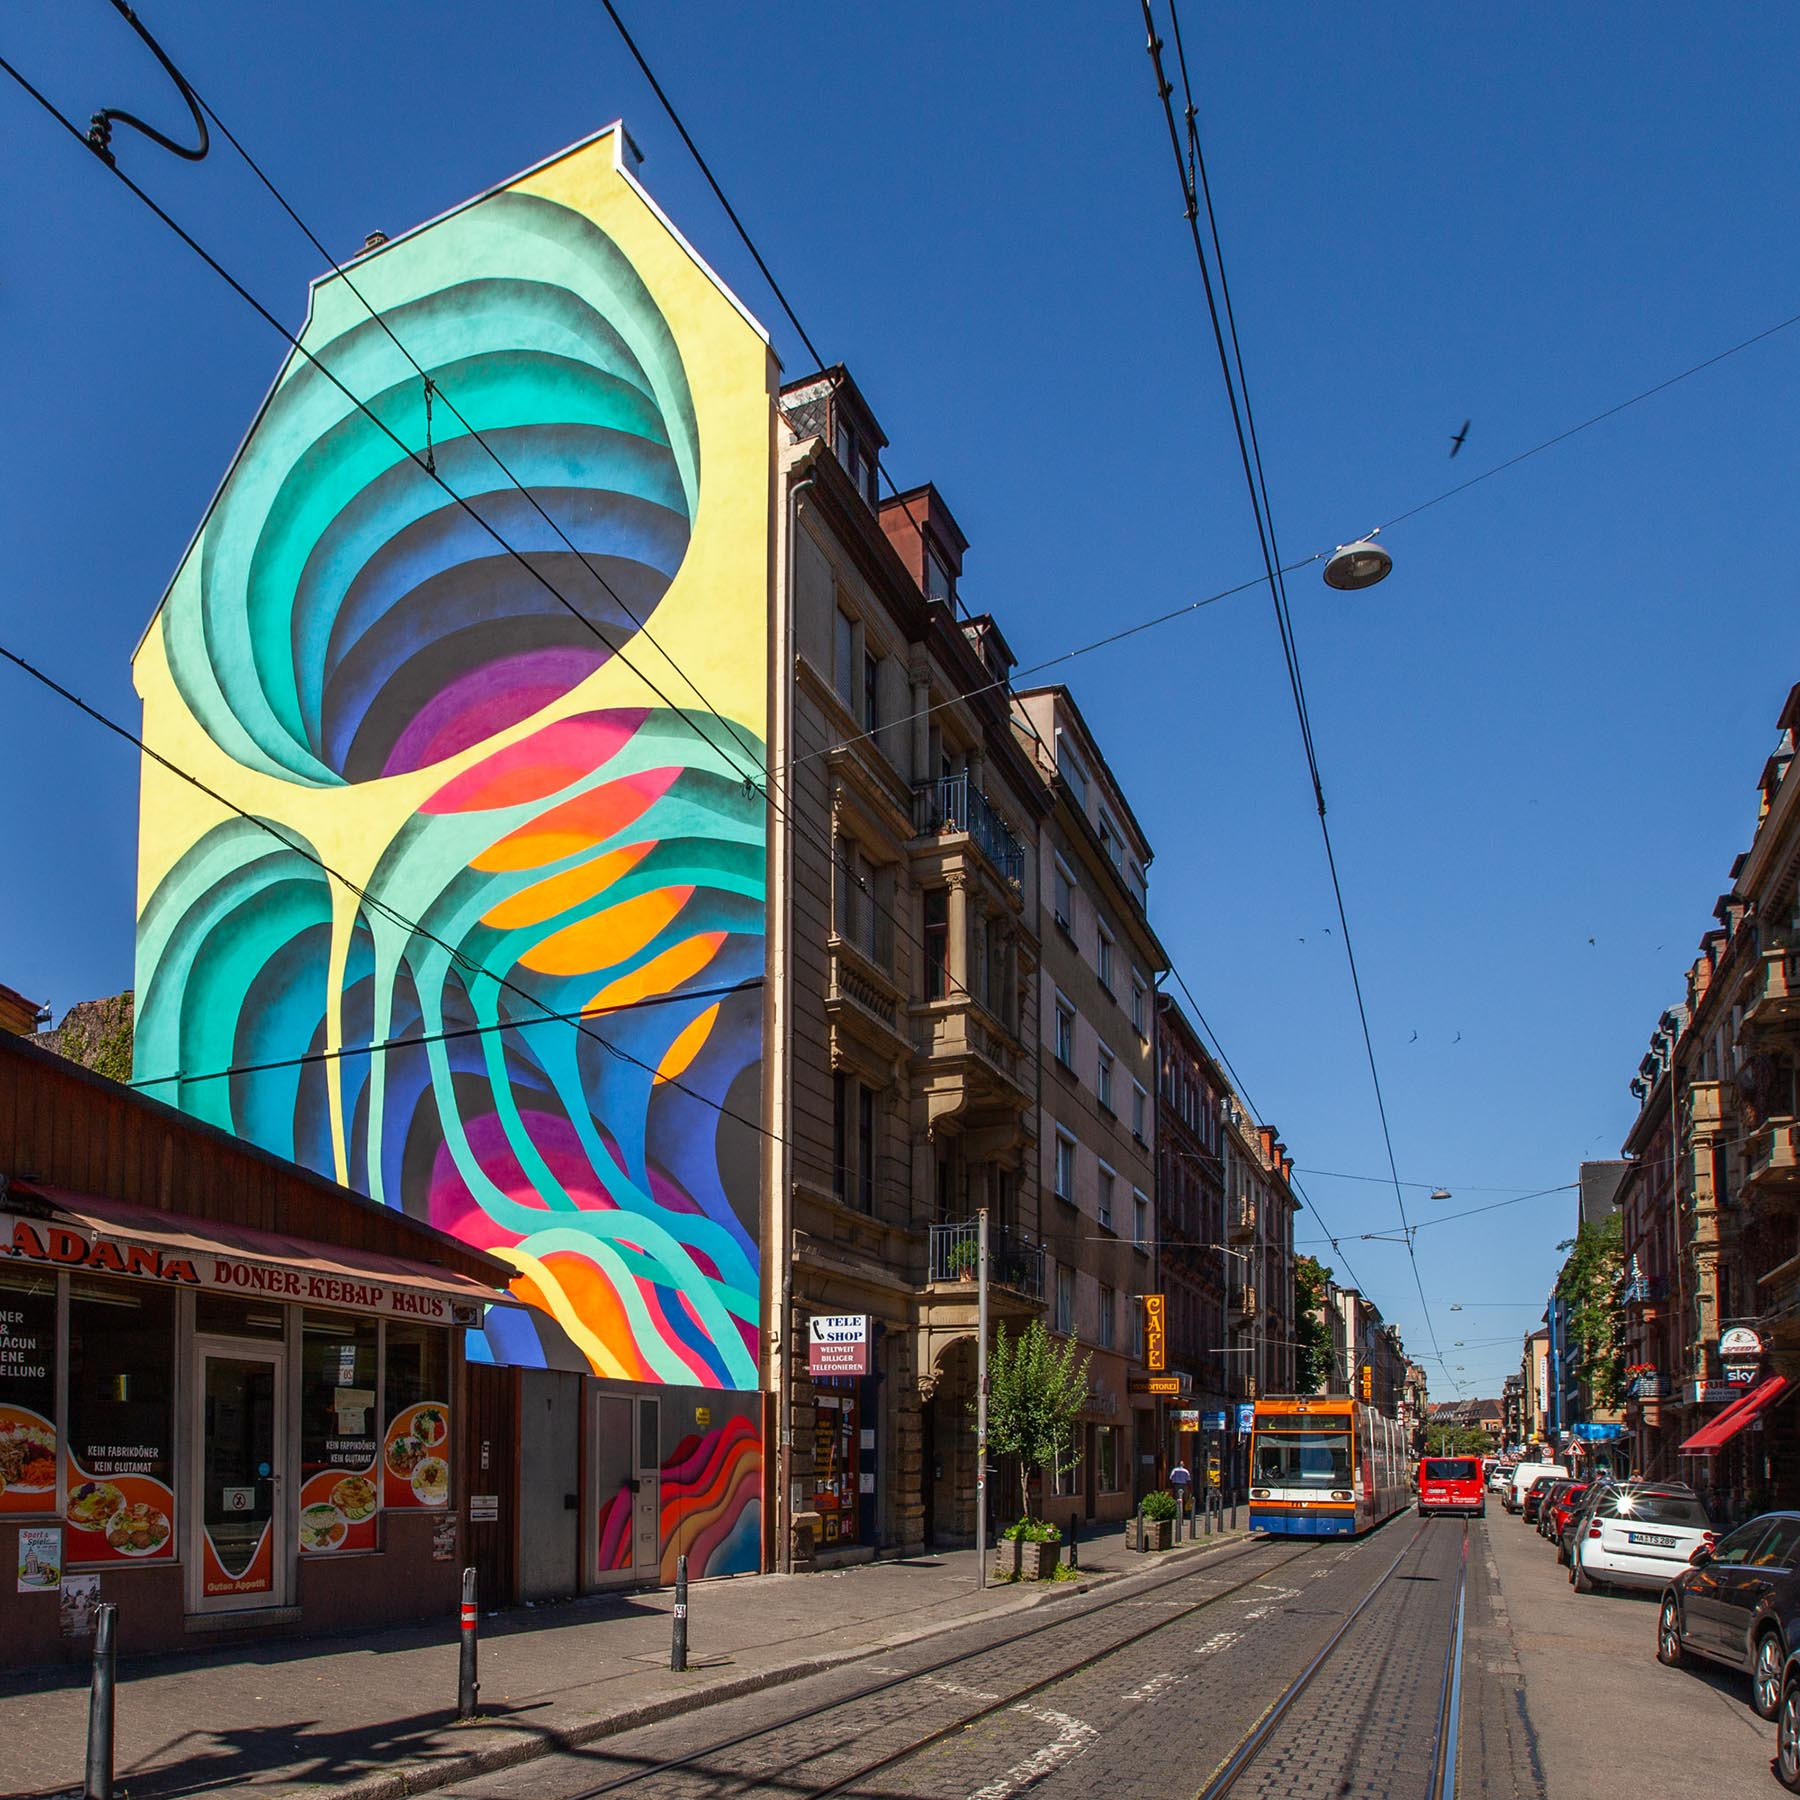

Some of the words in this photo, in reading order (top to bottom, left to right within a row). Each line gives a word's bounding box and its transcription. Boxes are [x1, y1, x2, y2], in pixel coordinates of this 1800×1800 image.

[0, 1221, 200, 1283] ADANA
[391, 1291, 444, 1317] HAUS
[826, 1317, 862, 1327] TELE
[827, 1332, 863, 1341] SHOP
[1146, 1297, 1161, 1368] CAFE
[812, 1363, 863, 1371] TELEFONIEREN
[1727, 1370, 1756, 1383] sky
[326, 1441, 339, 1450] KEIN
[87, 1445, 106, 1457] KEIN
[107, 1445, 159, 1458] FABRIKDÖNER
[331, 1454, 343, 1463] KEIN
[94, 1461, 112, 1472] KEIN
[114, 1462, 152, 1473] GLUTAMAT
[1650, 1535, 1659, 1543] TS
[1660, 1537, 1675, 1545] 289
[207, 1582, 233, 1591] Guten
[235, 1579, 266, 1590] Appetit
